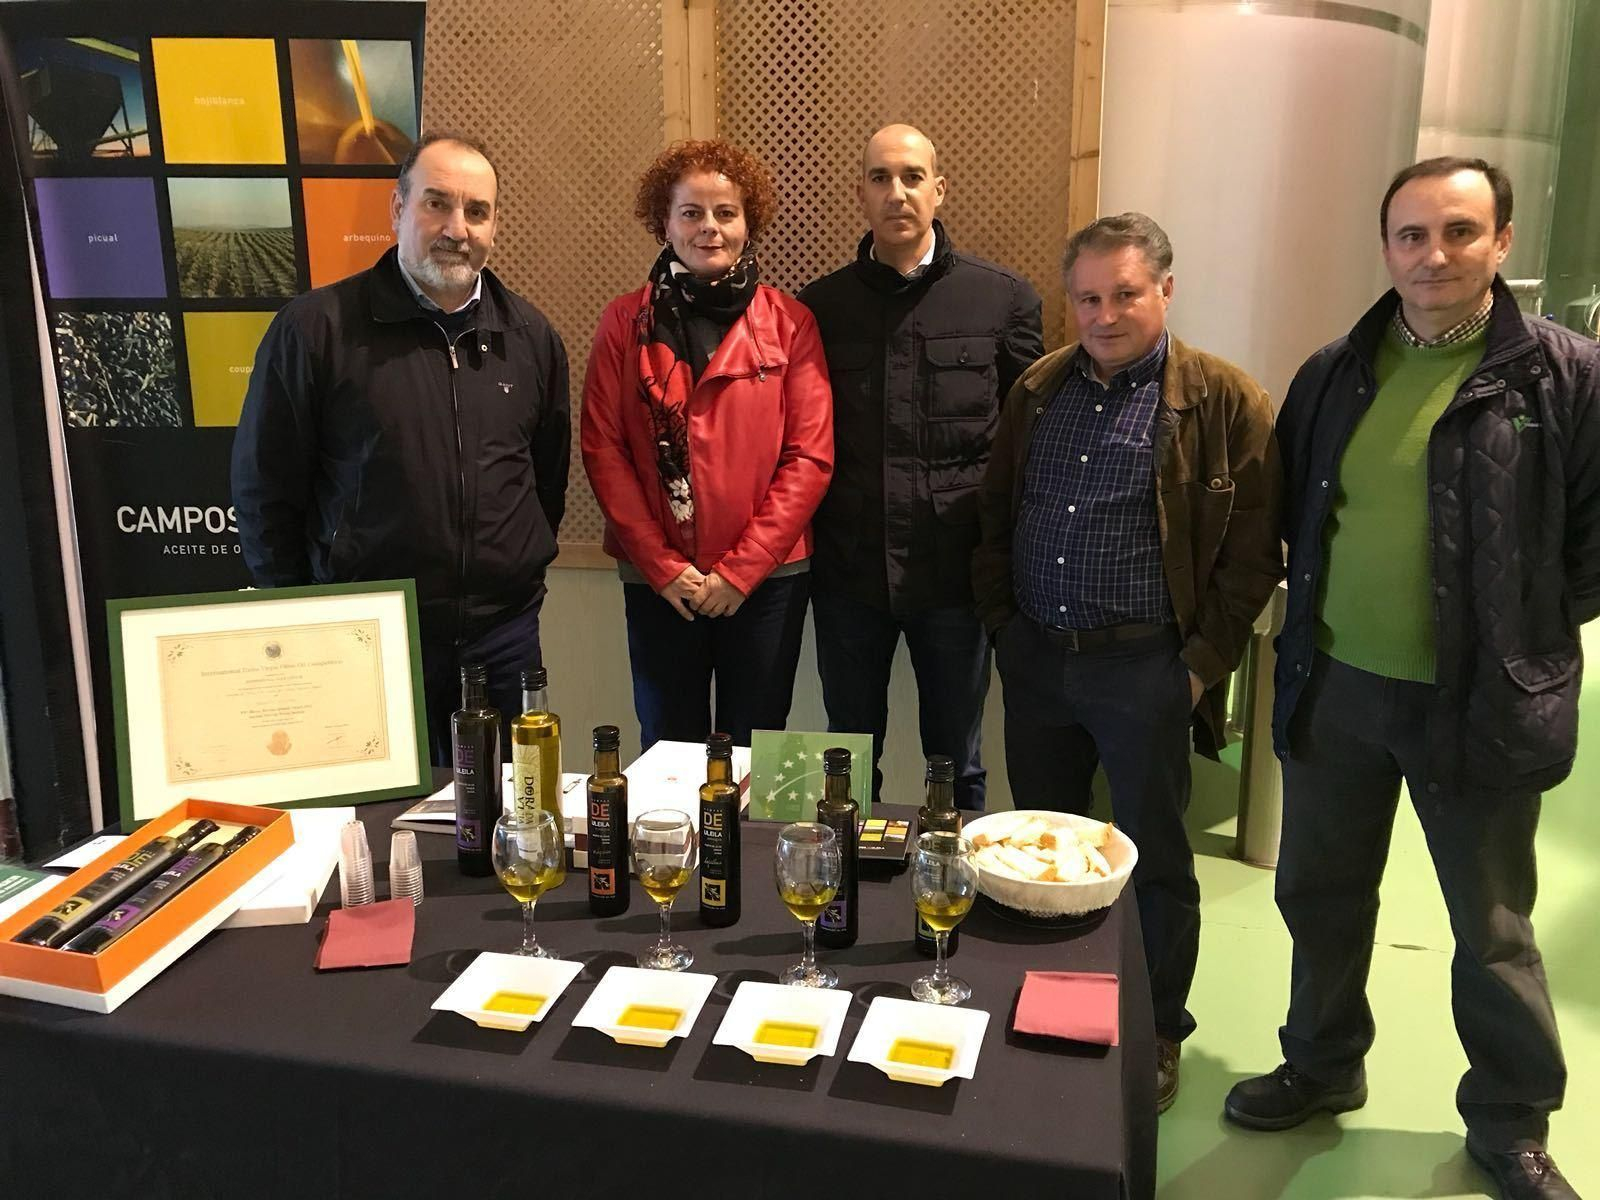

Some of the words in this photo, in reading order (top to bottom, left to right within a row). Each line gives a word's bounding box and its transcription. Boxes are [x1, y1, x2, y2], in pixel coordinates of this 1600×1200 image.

[88, 233, 118, 244] picual
[343, 234, 391, 243] arbequino
[116, 505, 239, 534] CAMPOS
[163, 545, 206, 555] ACEITE
[212, 545, 227, 555] DE
[591, 802, 610, 817] DE
[704, 811, 723, 827] DE
